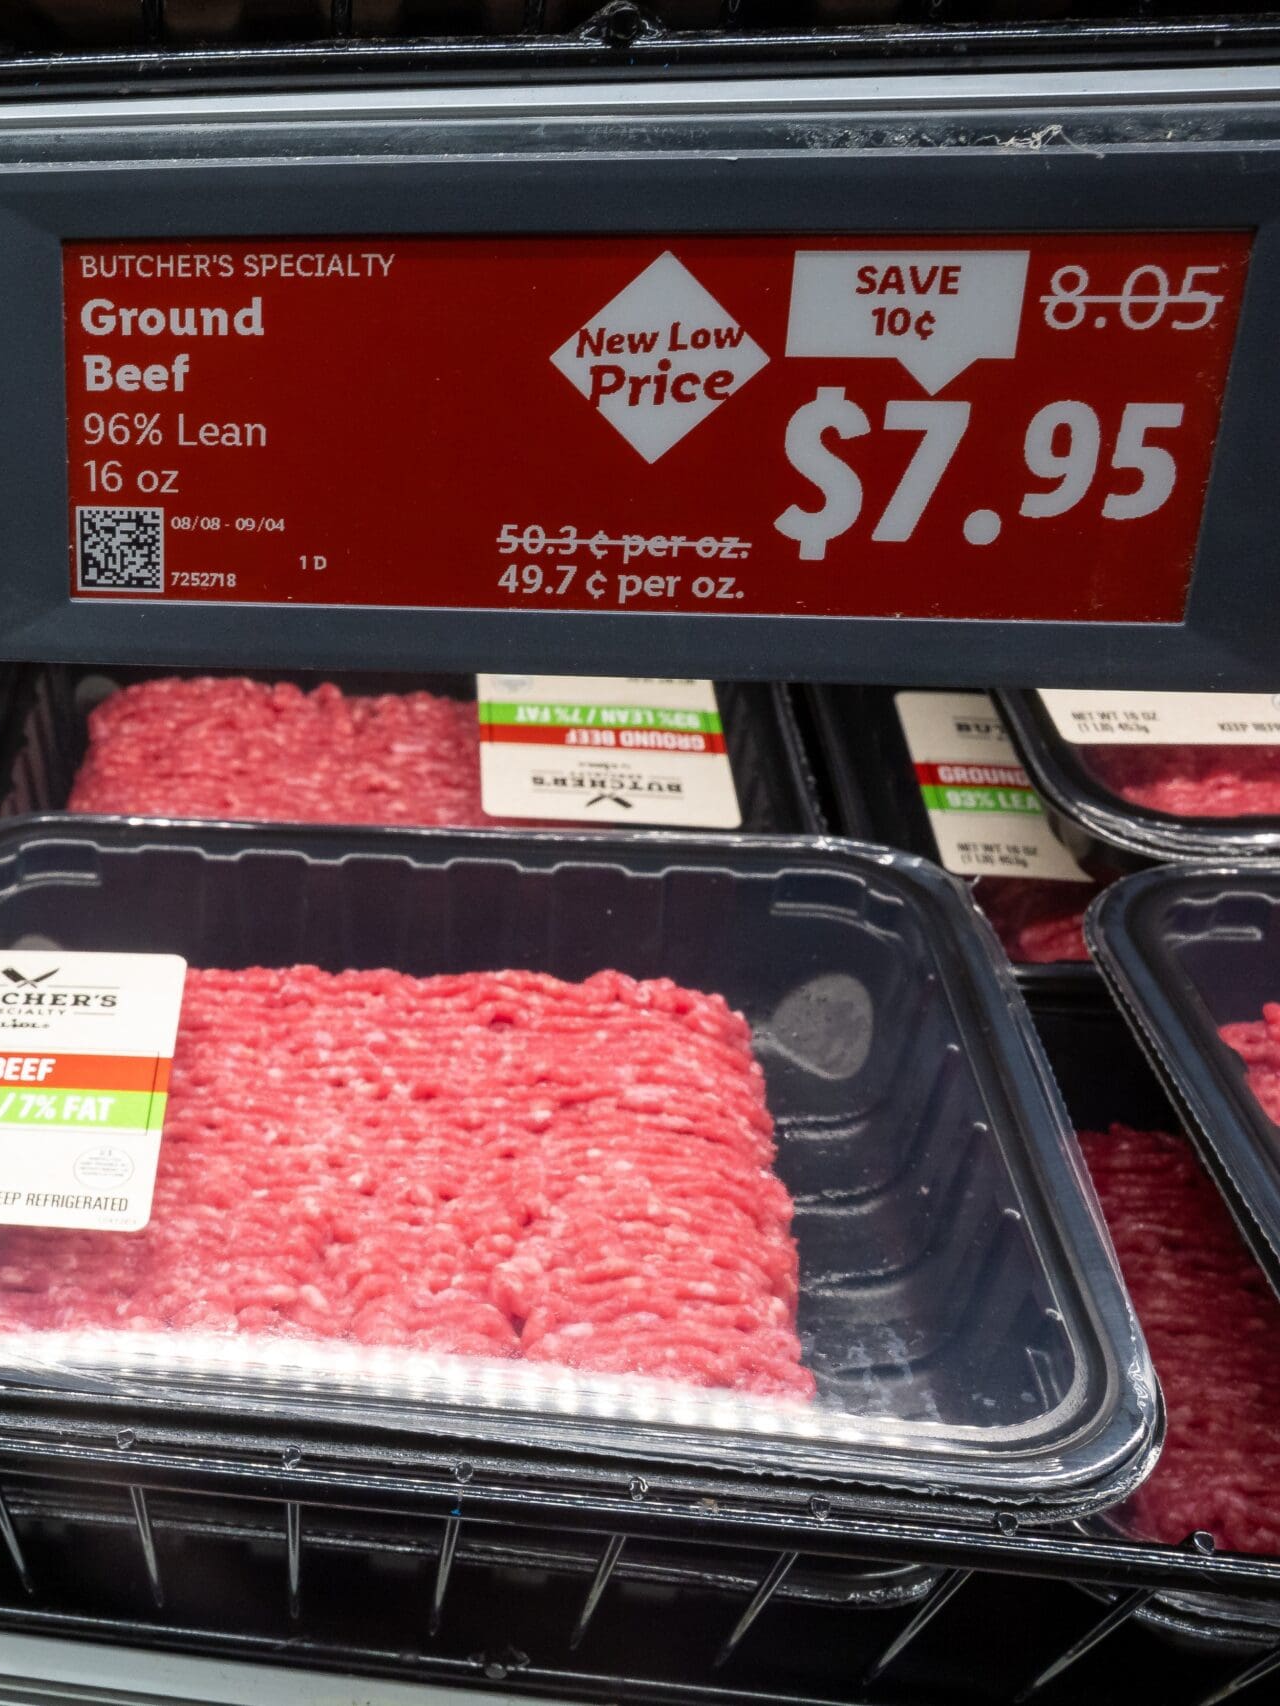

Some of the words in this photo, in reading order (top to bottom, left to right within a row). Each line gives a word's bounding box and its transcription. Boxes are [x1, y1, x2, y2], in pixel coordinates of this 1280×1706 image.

[80, 254, 235, 278] BUTCHER'S
[244, 253, 395, 278] SPECIALTY
[856, 264, 962, 296] SAVE
[1040, 264, 1224, 331] 8.05
[80, 296, 265, 336] Ground
[871, 307, 937, 340] 10¢
[576, 326, 661, 358] New
[668, 322, 746, 352] Low
[83, 354, 190, 392] Beef
[588, 364, 736, 408] Price
[83, 413, 163, 446] 96%
[178, 413, 267, 447] Lean
[83, 459, 123, 492] 16
[136, 469, 179, 493] oz
[772, 386, 1186, 561] $7.95
[170, 516, 220, 532] 08/08
[235, 517, 285, 532] 09/04
[313, 556, 328, 570] D
[622, 534, 686, 563] per
[171, 572, 236, 588] 7252718
[617, 573, 682, 603] per
[691, 574, 746, 600] oz.
[515, 704, 550, 721] FAT
[565, 729, 615, 746] BEEF
[620, 730, 705, 751] GROUND
[998, 791, 1043, 811] LEA
[21, 1094, 57, 1120] 7%
[63, 1096, 116, 1122] FAT
[25, 1193, 129, 1213] REFRIGERATED
